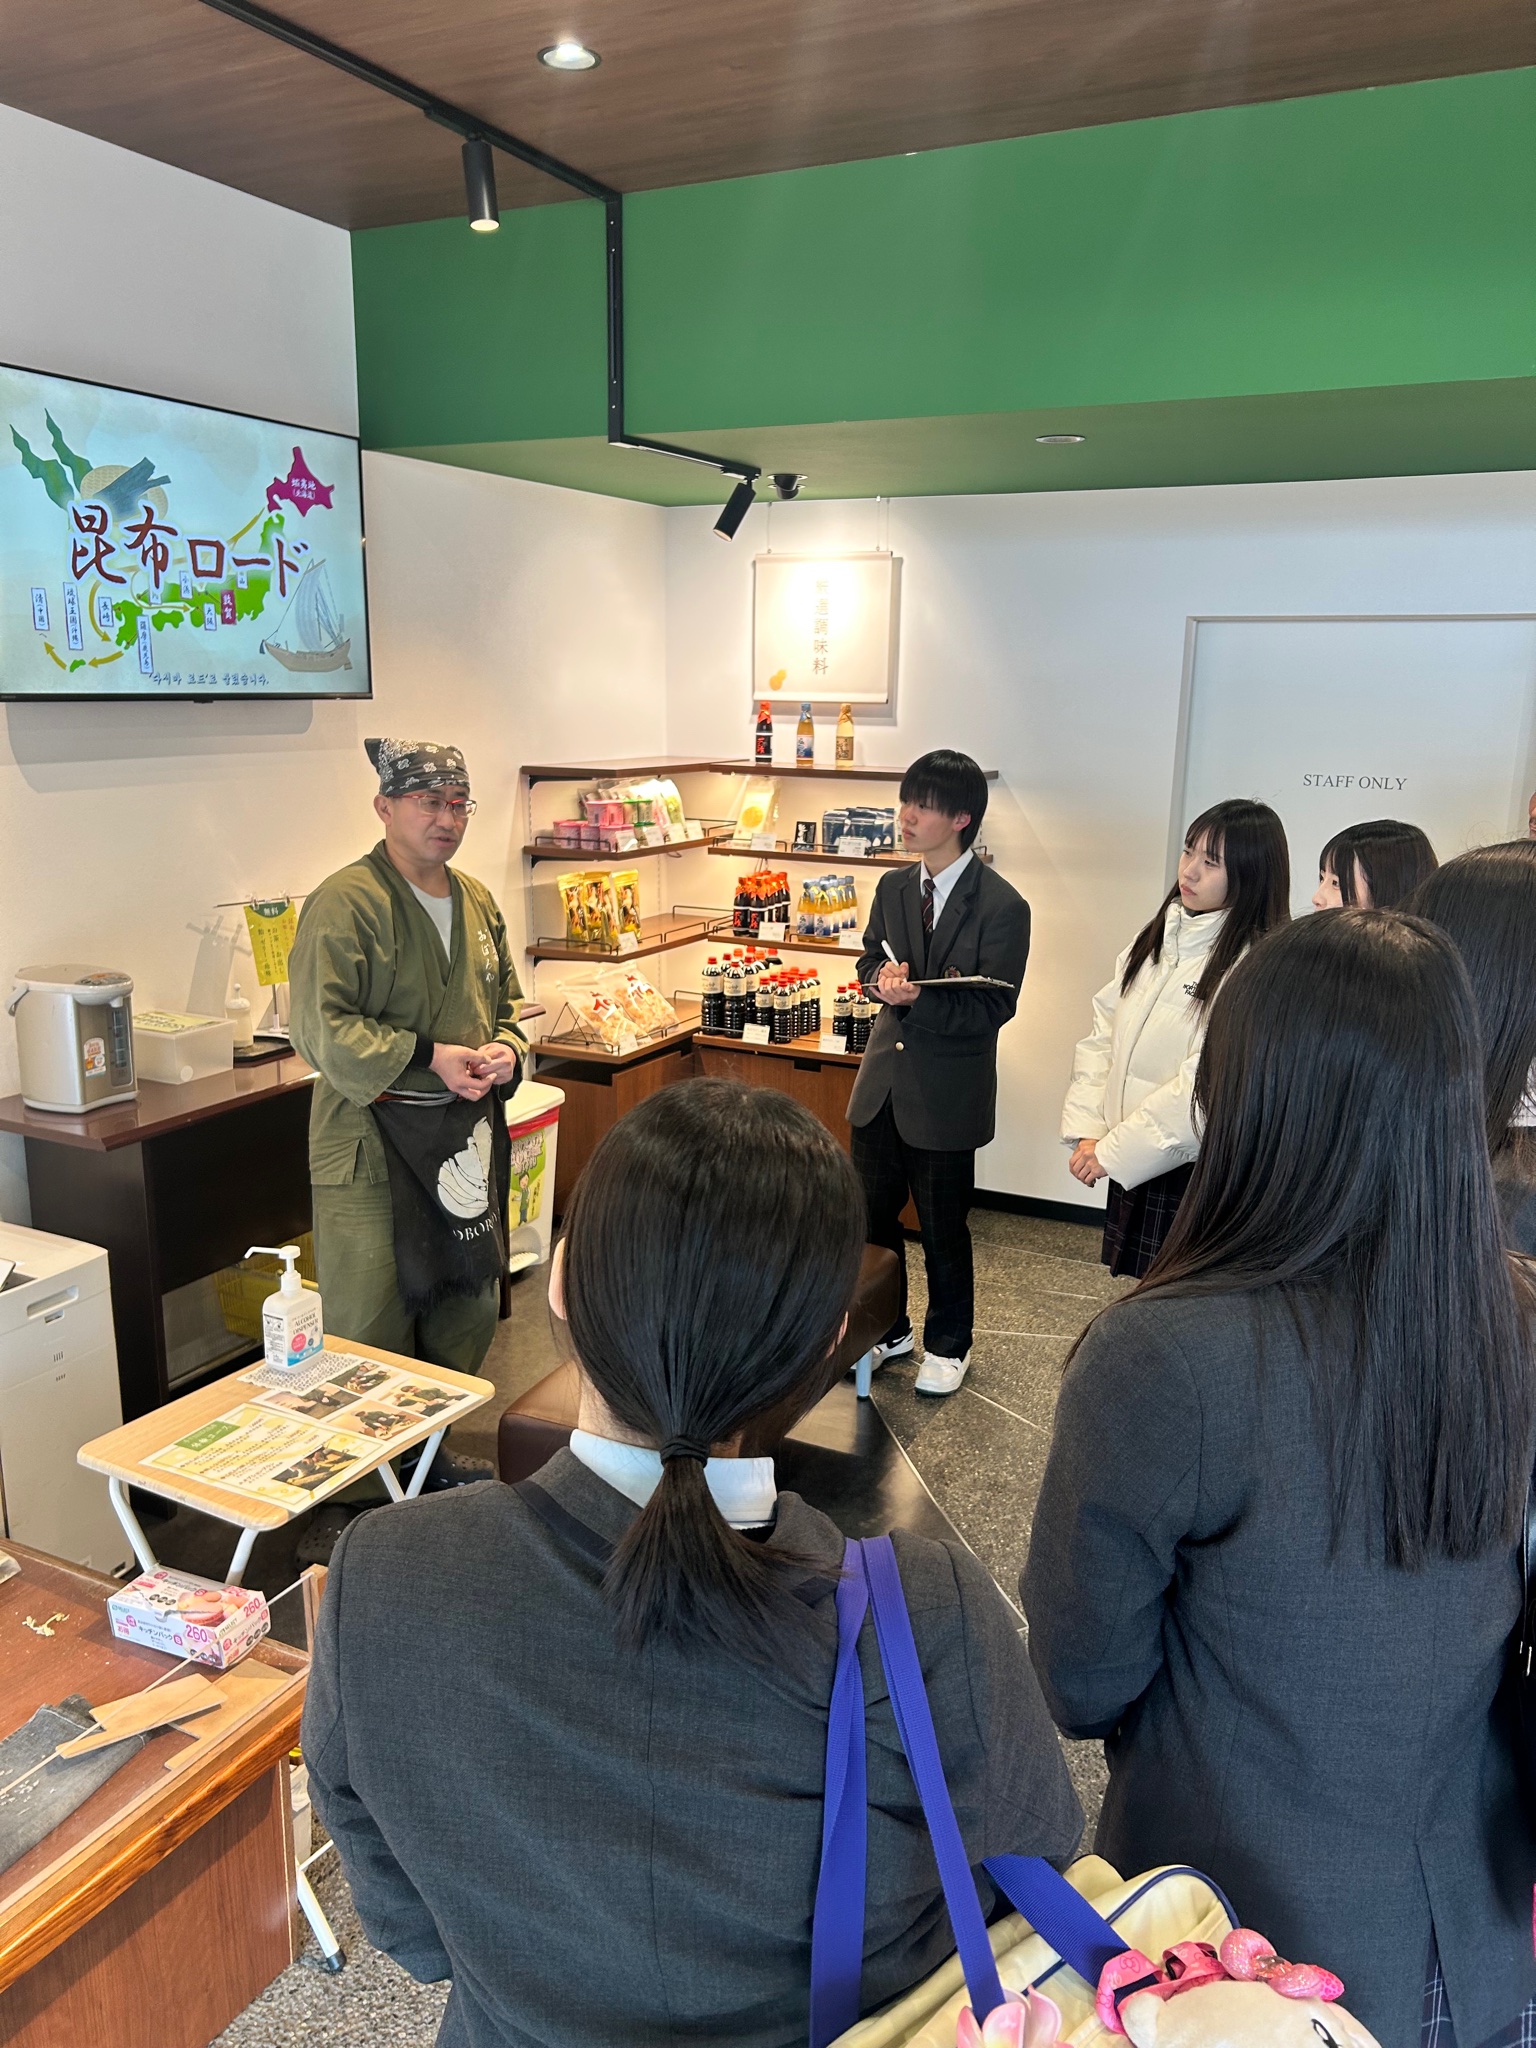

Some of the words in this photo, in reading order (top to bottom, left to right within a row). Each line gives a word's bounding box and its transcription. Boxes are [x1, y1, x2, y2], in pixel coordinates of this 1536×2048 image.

[71, 504, 309, 598] 昆布ロード
[222, 594, 234, 620] 敦賀
[1302, 773, 1355, 788] STAFF
[1358, 776, 1408, 791] ONLY
[243, 1597, 261, 1618] 260
[138, 1626, 173, 1641] キッチンパック
[185, 1623, 208, 1643] 260
